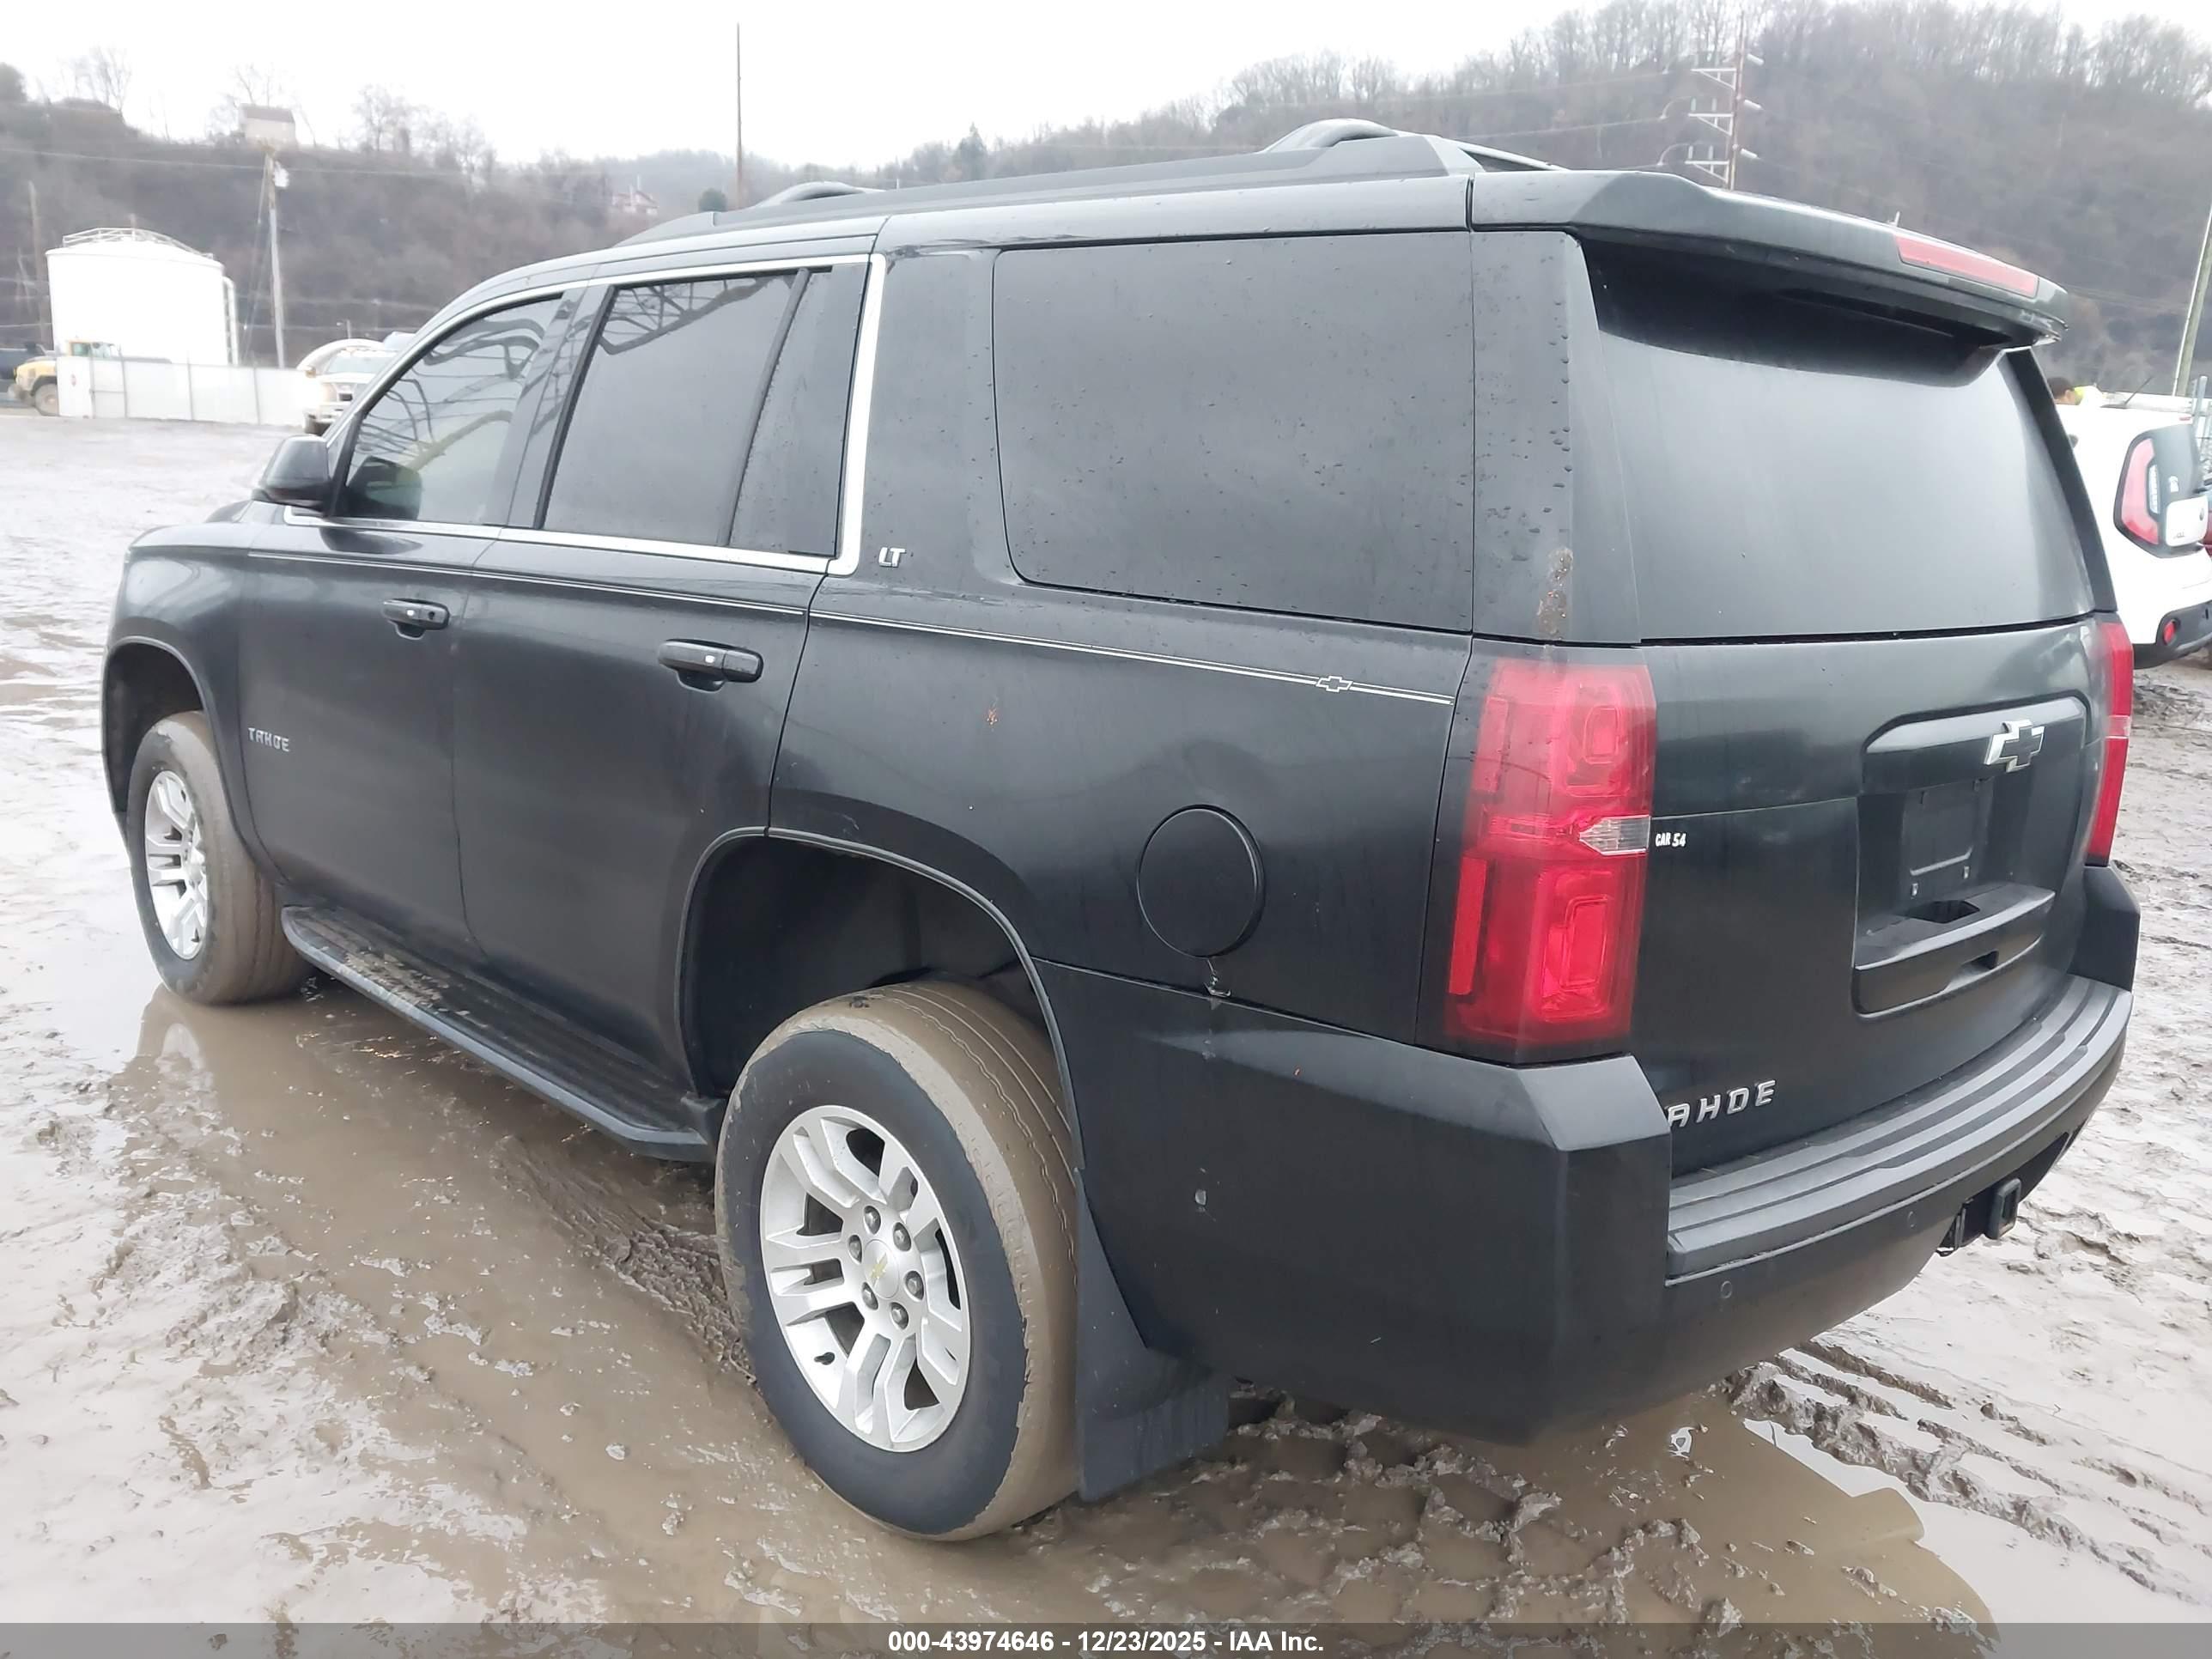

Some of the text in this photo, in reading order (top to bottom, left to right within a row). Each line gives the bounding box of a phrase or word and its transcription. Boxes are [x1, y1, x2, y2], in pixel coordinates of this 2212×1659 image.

[878, 546, 906, 568] LT
[247, 727, 289, 752] TAHOE
[1655, 831, 1687, 848] CAR 54
[1667, 1079, 1776, 1127] AHOE
